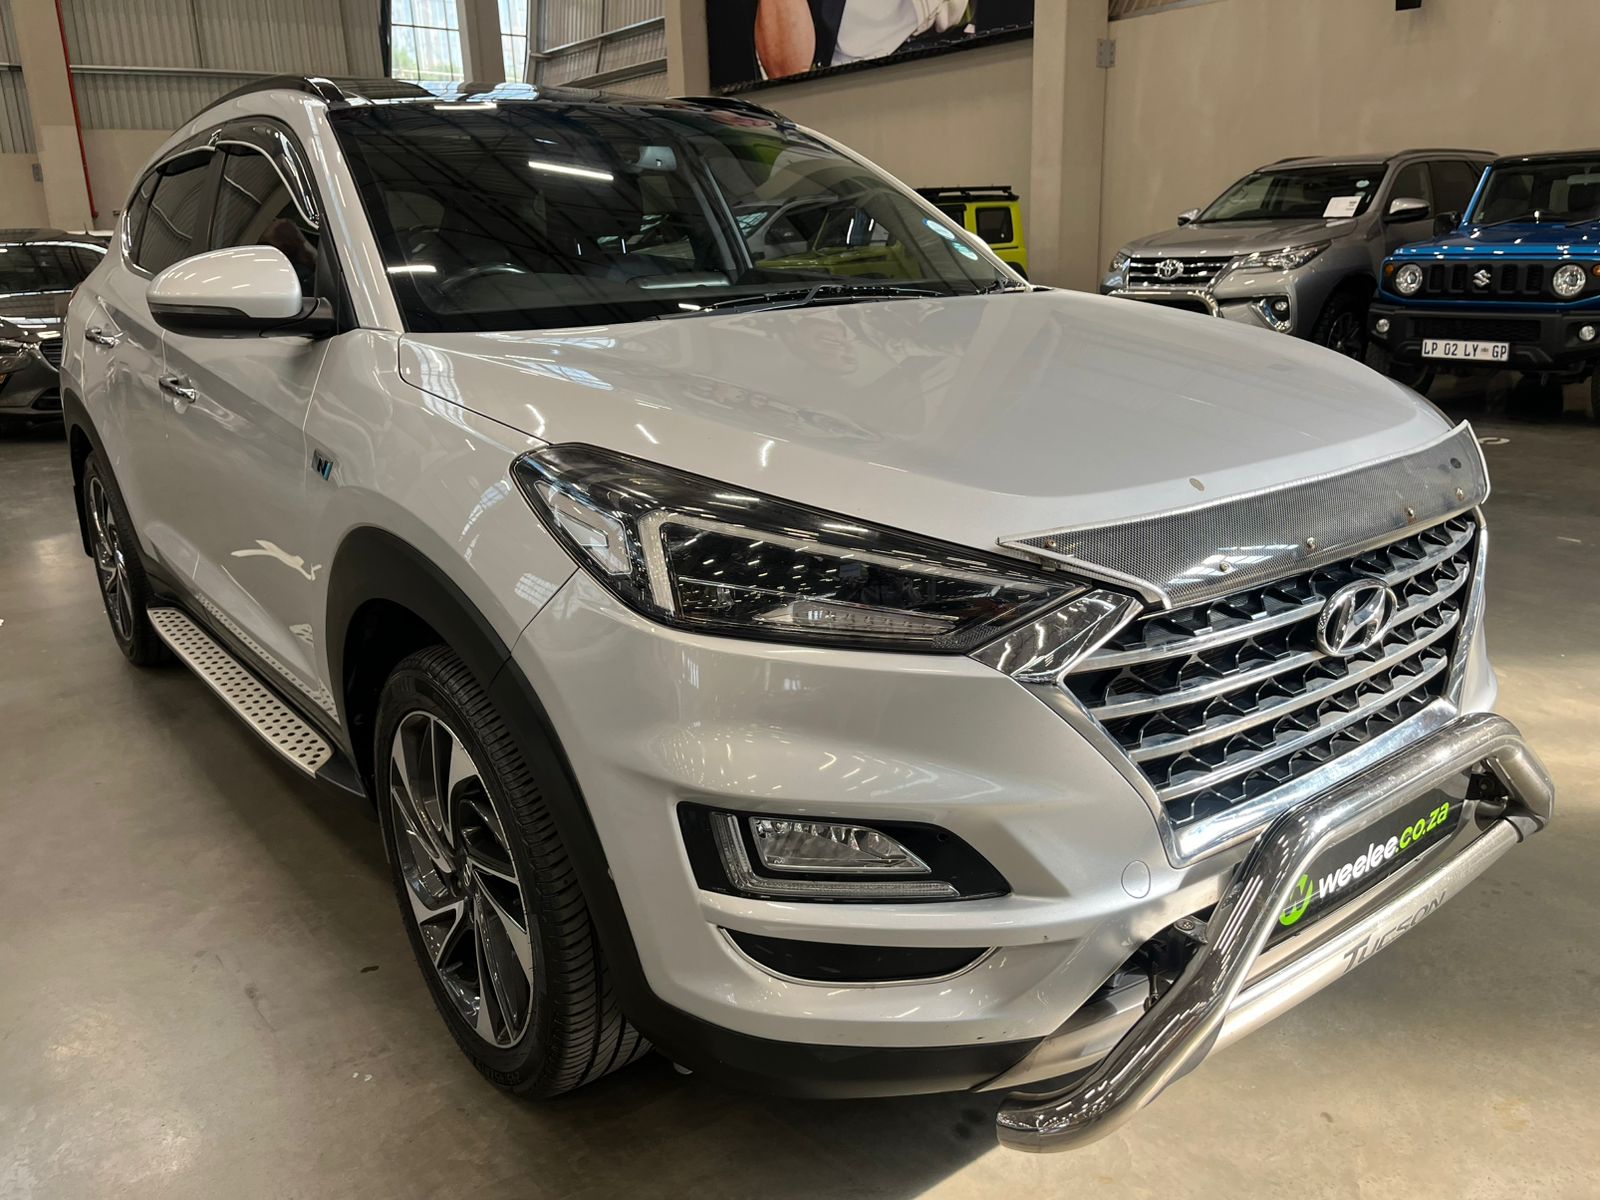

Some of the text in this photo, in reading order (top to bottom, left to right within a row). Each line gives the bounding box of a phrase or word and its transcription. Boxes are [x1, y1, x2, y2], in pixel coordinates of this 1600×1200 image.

[1423, 341, 1507, 358] LP 02 LY GP
[1319, 802, 1450, 899] weelee.co.za
[1343, 891, 1447, 974] TUCSON
